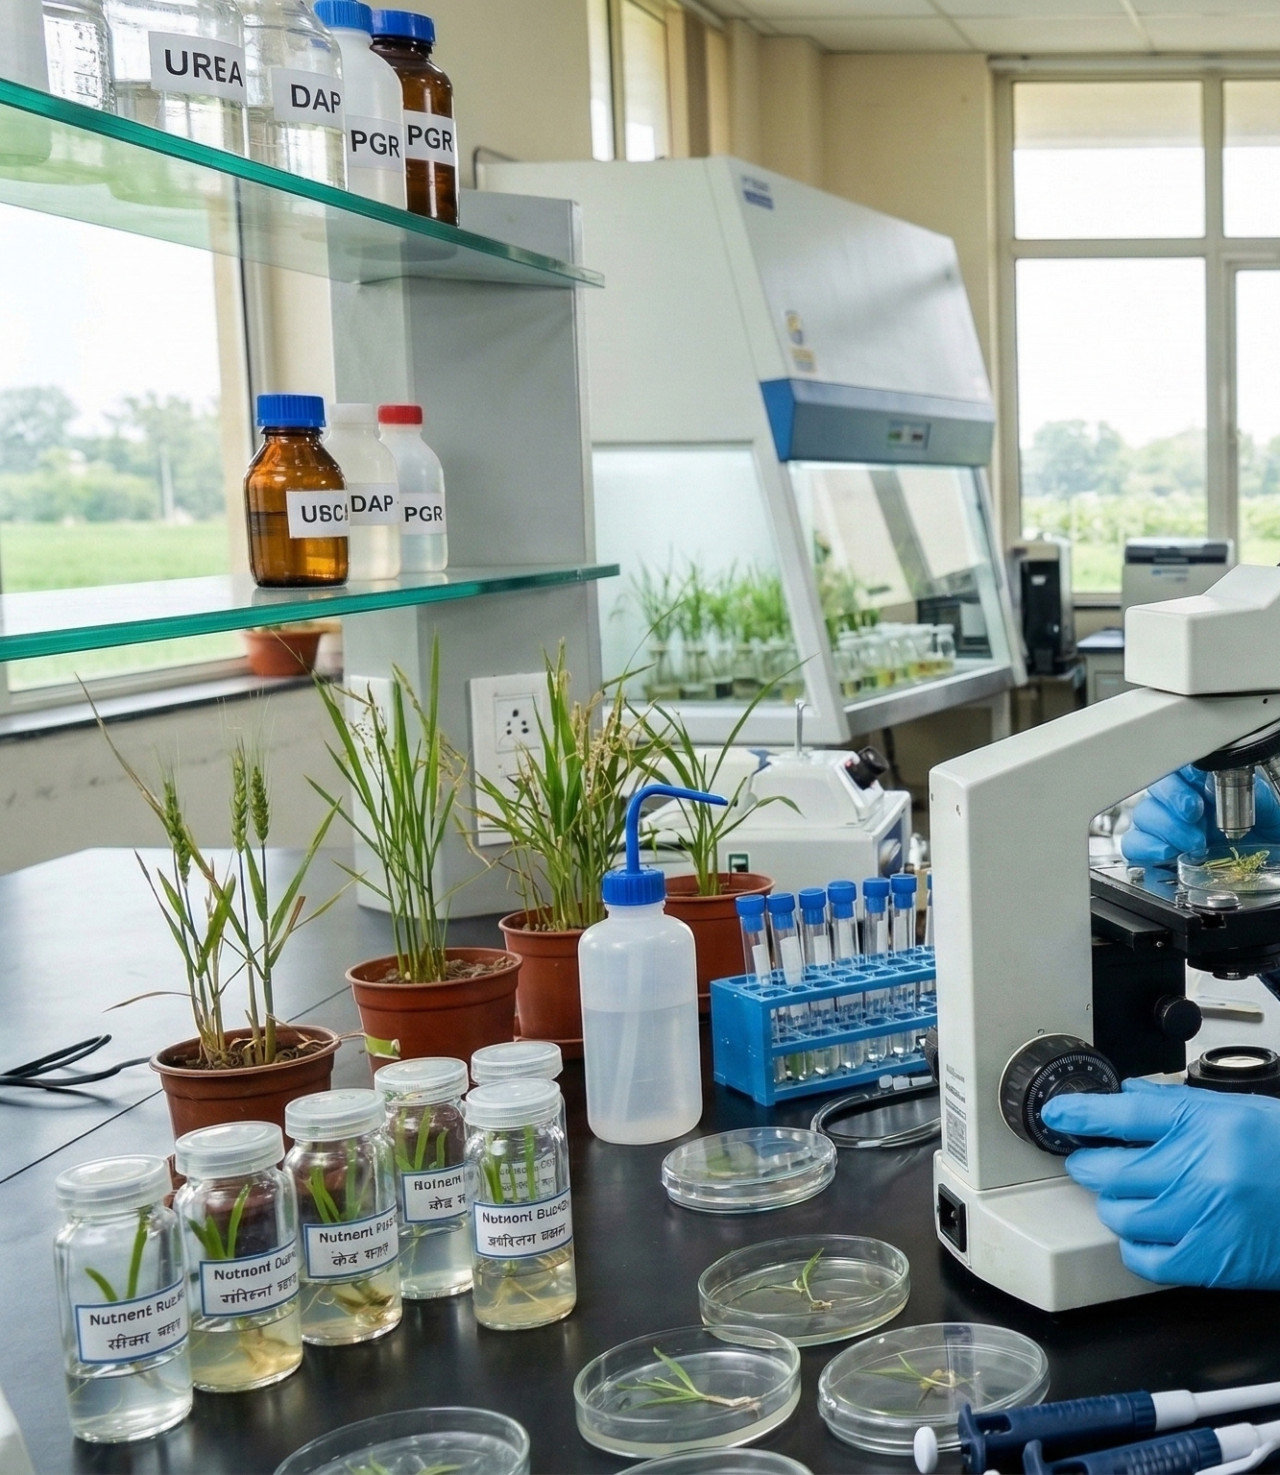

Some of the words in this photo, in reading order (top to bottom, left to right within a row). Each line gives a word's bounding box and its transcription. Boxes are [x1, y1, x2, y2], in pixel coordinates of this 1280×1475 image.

[164, 48, 243, 88] UREA
[290, 83, 341, 114] DAP
[351, 129, 400, 158] PGR
[407, 124, 452, 152] PGR
[350, 495, 394, 513] DAP
[404, 506, 444, 522] PGR
